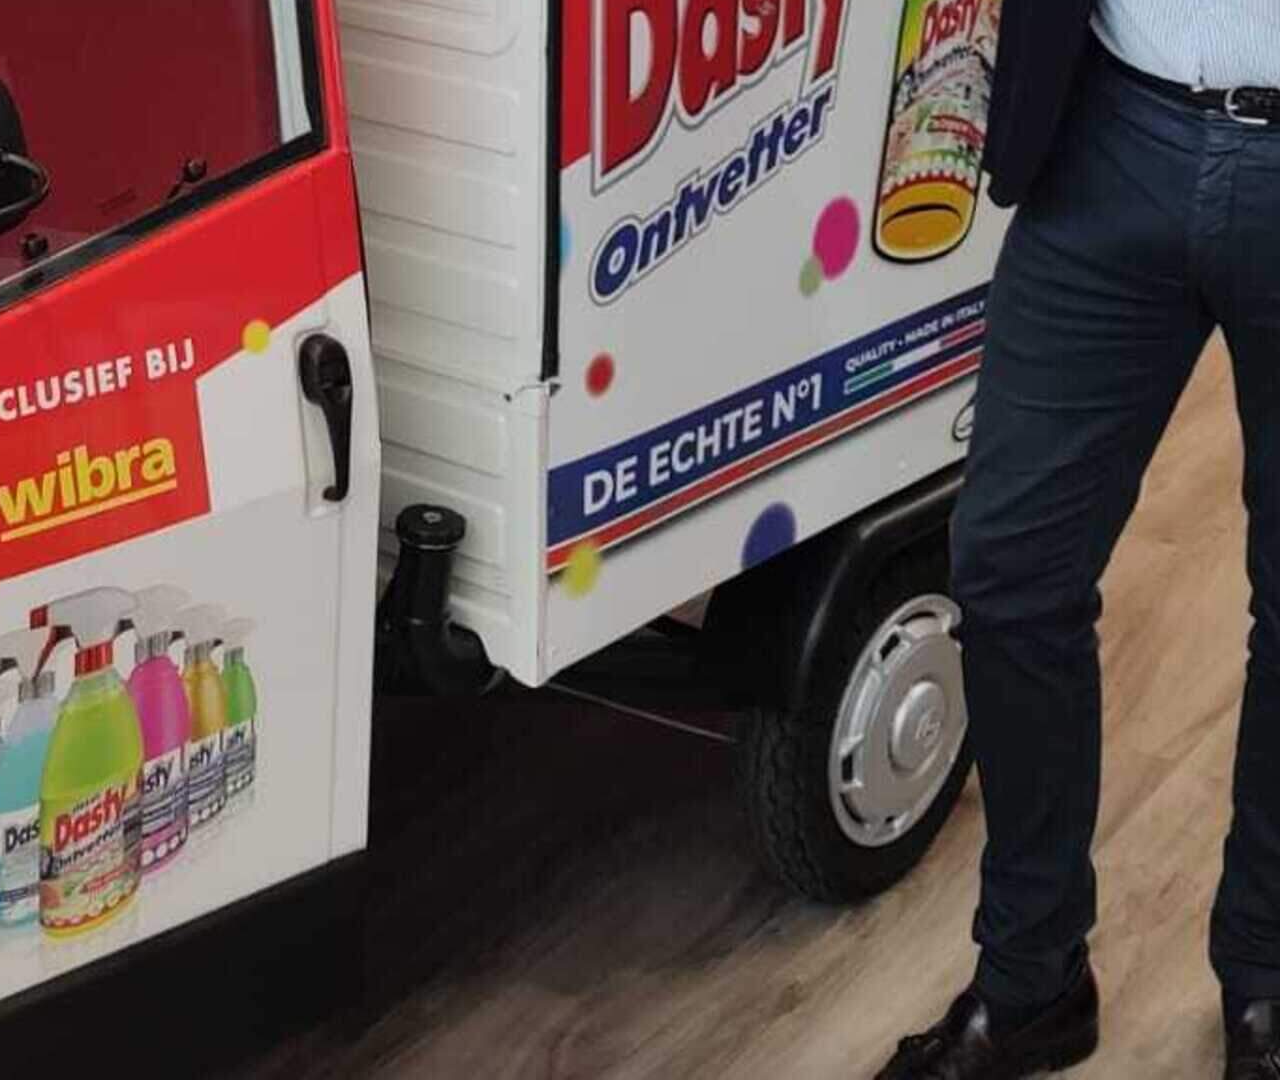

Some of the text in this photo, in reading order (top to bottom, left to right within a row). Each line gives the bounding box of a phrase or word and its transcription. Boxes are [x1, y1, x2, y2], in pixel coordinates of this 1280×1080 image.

[593, 88, 832, 297] Ontvetter
[146, 337, 197, 383] BIJ
[844, 337, 897, 373] QUALITY
[904, 319, 941, 345] MADE
[582, 456, 638, 516] DE
[648, 405, 764, 488] ECHTE
[4, 819, 40, 854] Das
[53, 784, 128, 854] Dasty
